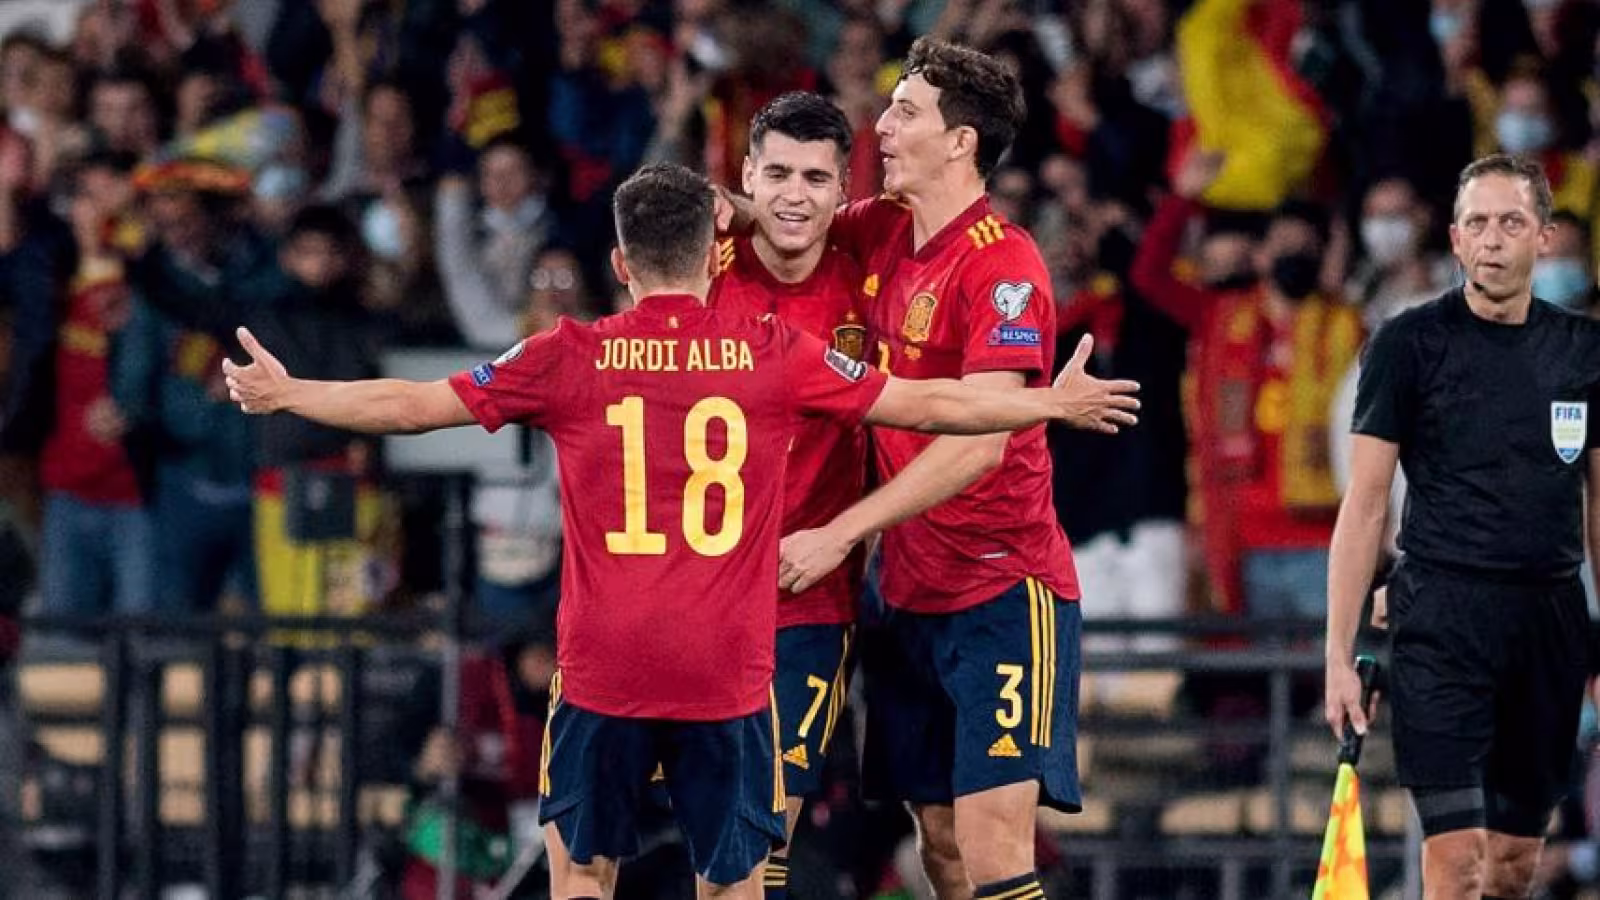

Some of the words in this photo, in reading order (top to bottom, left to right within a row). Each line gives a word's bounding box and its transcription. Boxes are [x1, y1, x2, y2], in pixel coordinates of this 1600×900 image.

[595, 338, 679, 372] JORDI
[686, 339, 754, 371] ALBA
[1555, 406, 1582, 420] FIFA
[606, 397, 747, 556] 18
[798, 674, 829, 738] 7
[995, 664, 1023, 728] 3
